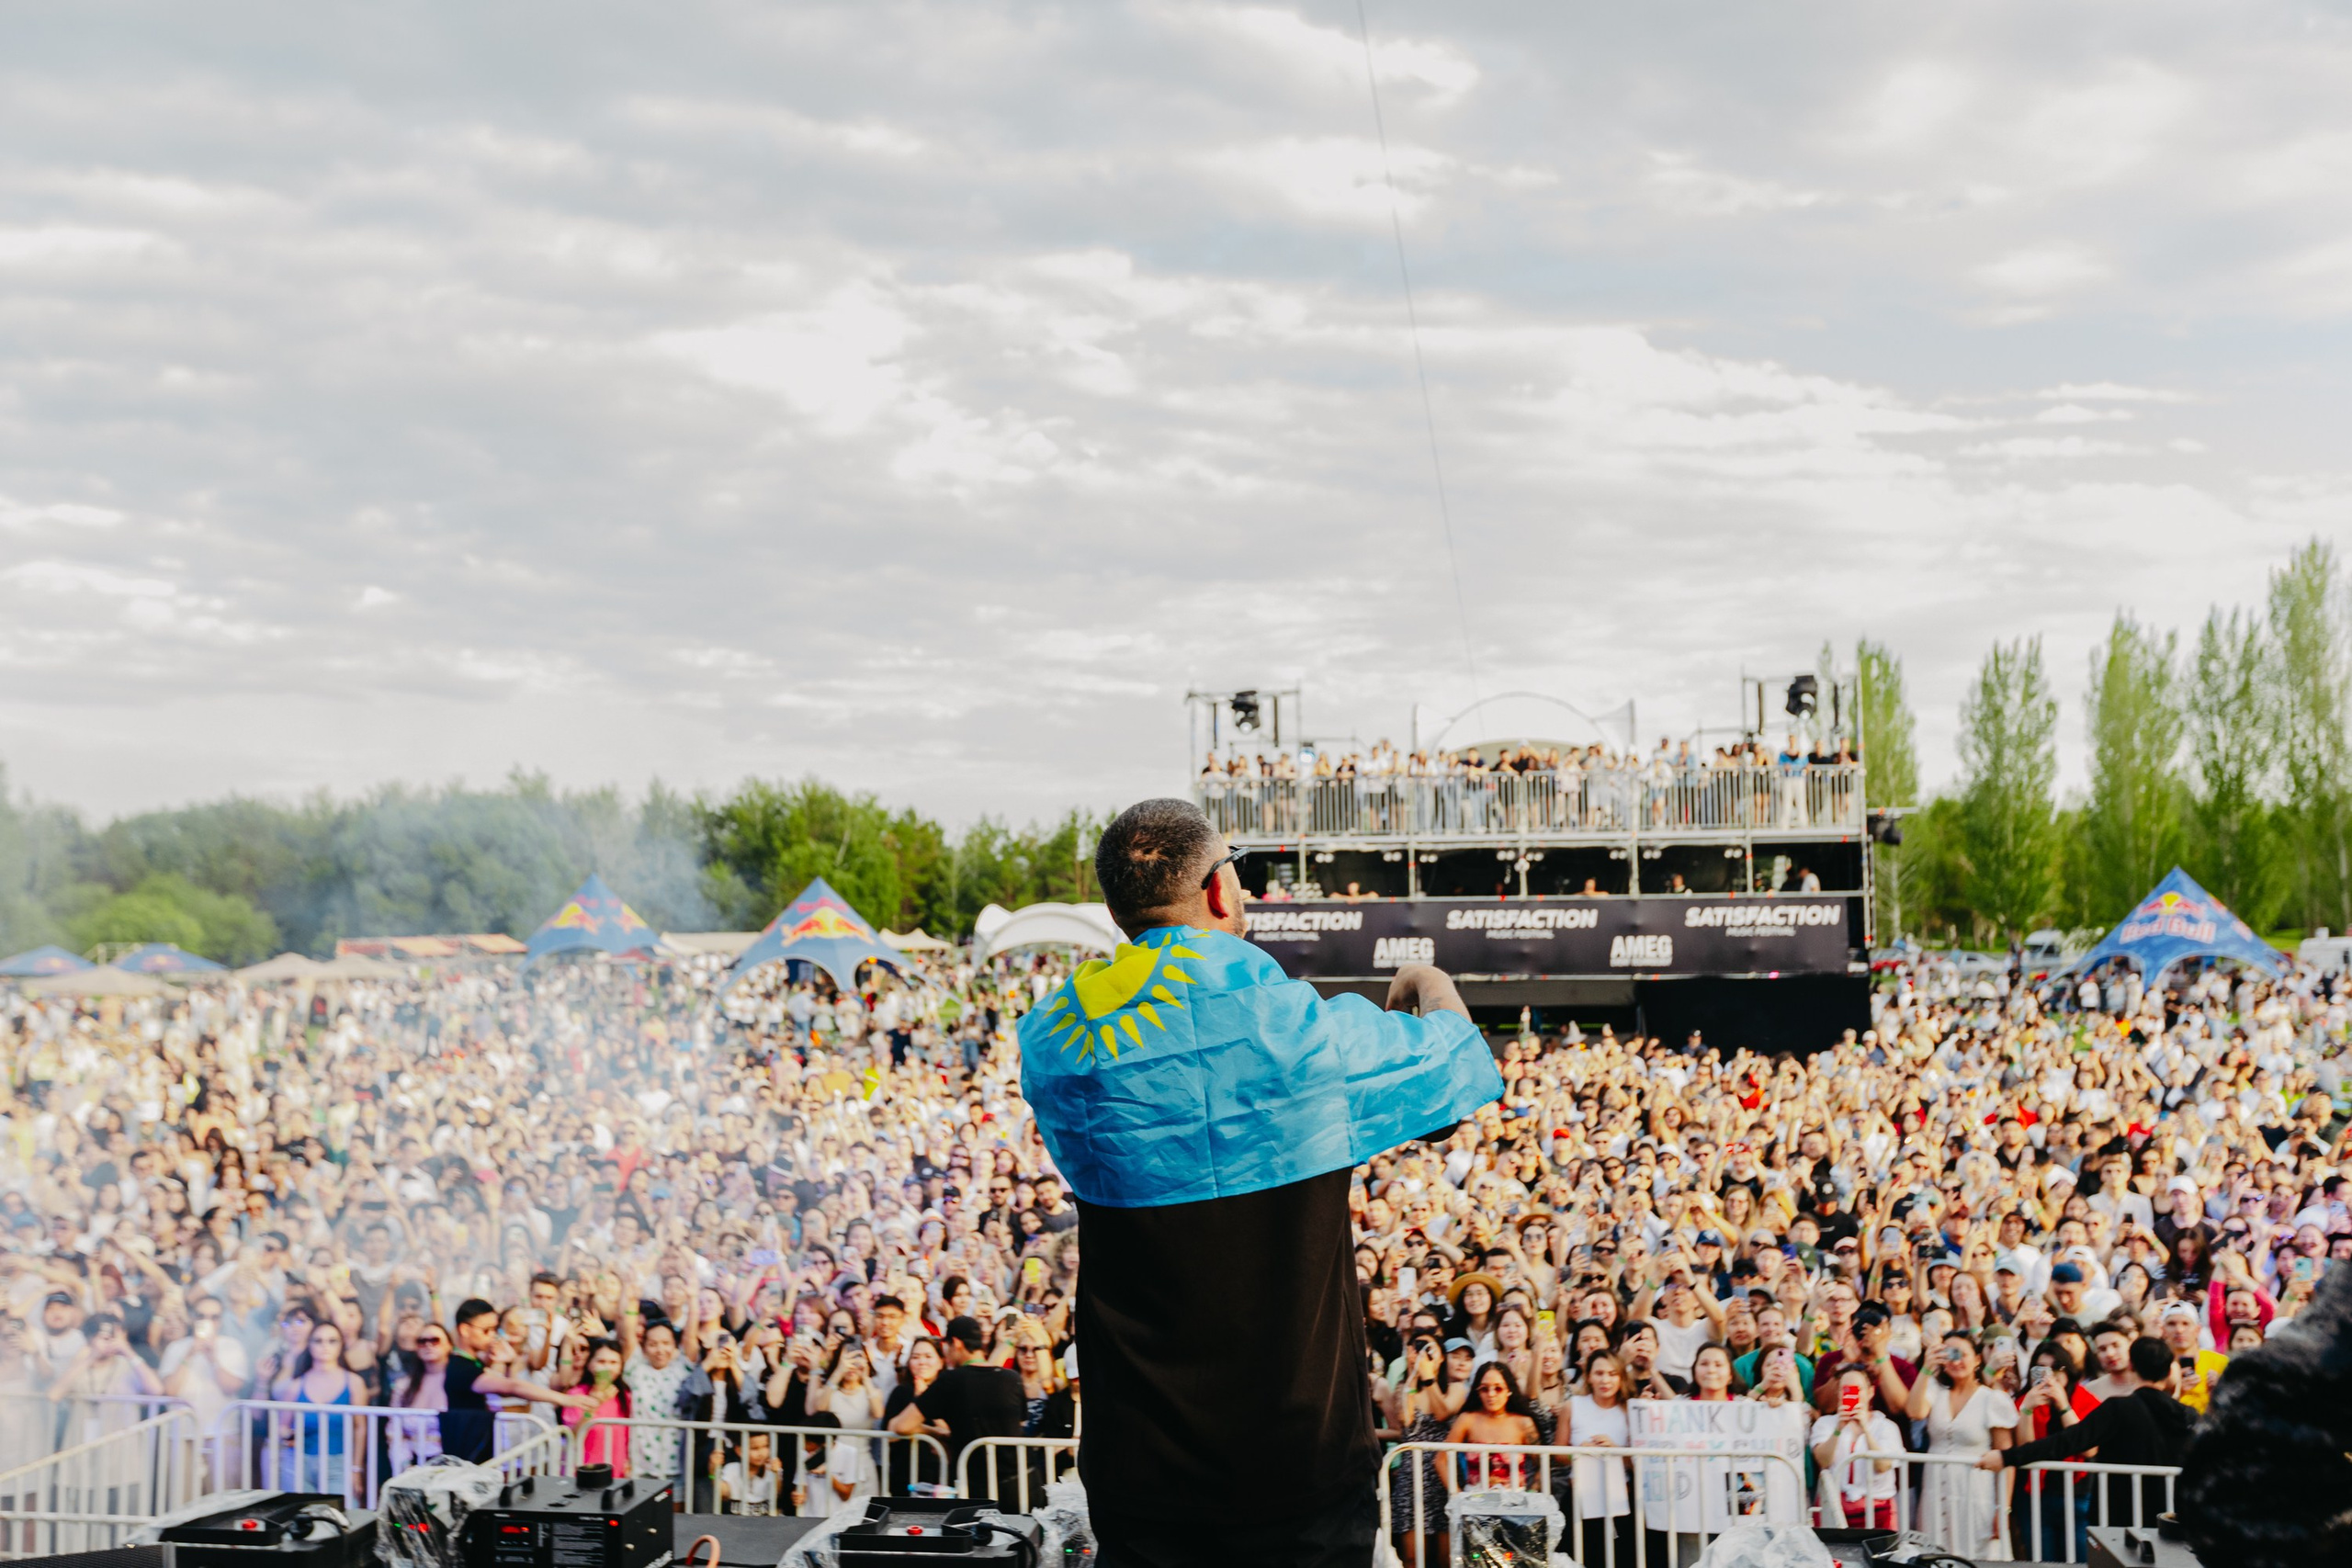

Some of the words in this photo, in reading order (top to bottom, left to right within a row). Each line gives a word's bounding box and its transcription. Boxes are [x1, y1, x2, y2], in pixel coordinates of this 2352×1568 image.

[1245, 911, 1363, 931] TISFACTION
[1446, 908, 1599, 930] SATISFACTION
[1684, 904, 1840, 927] SATISFACTION
[1374, 937, 1435, 961] AMEG
[1611, 935, 1673, 958] AMEG
[1633, 1404, 1725, 1434] THANK
